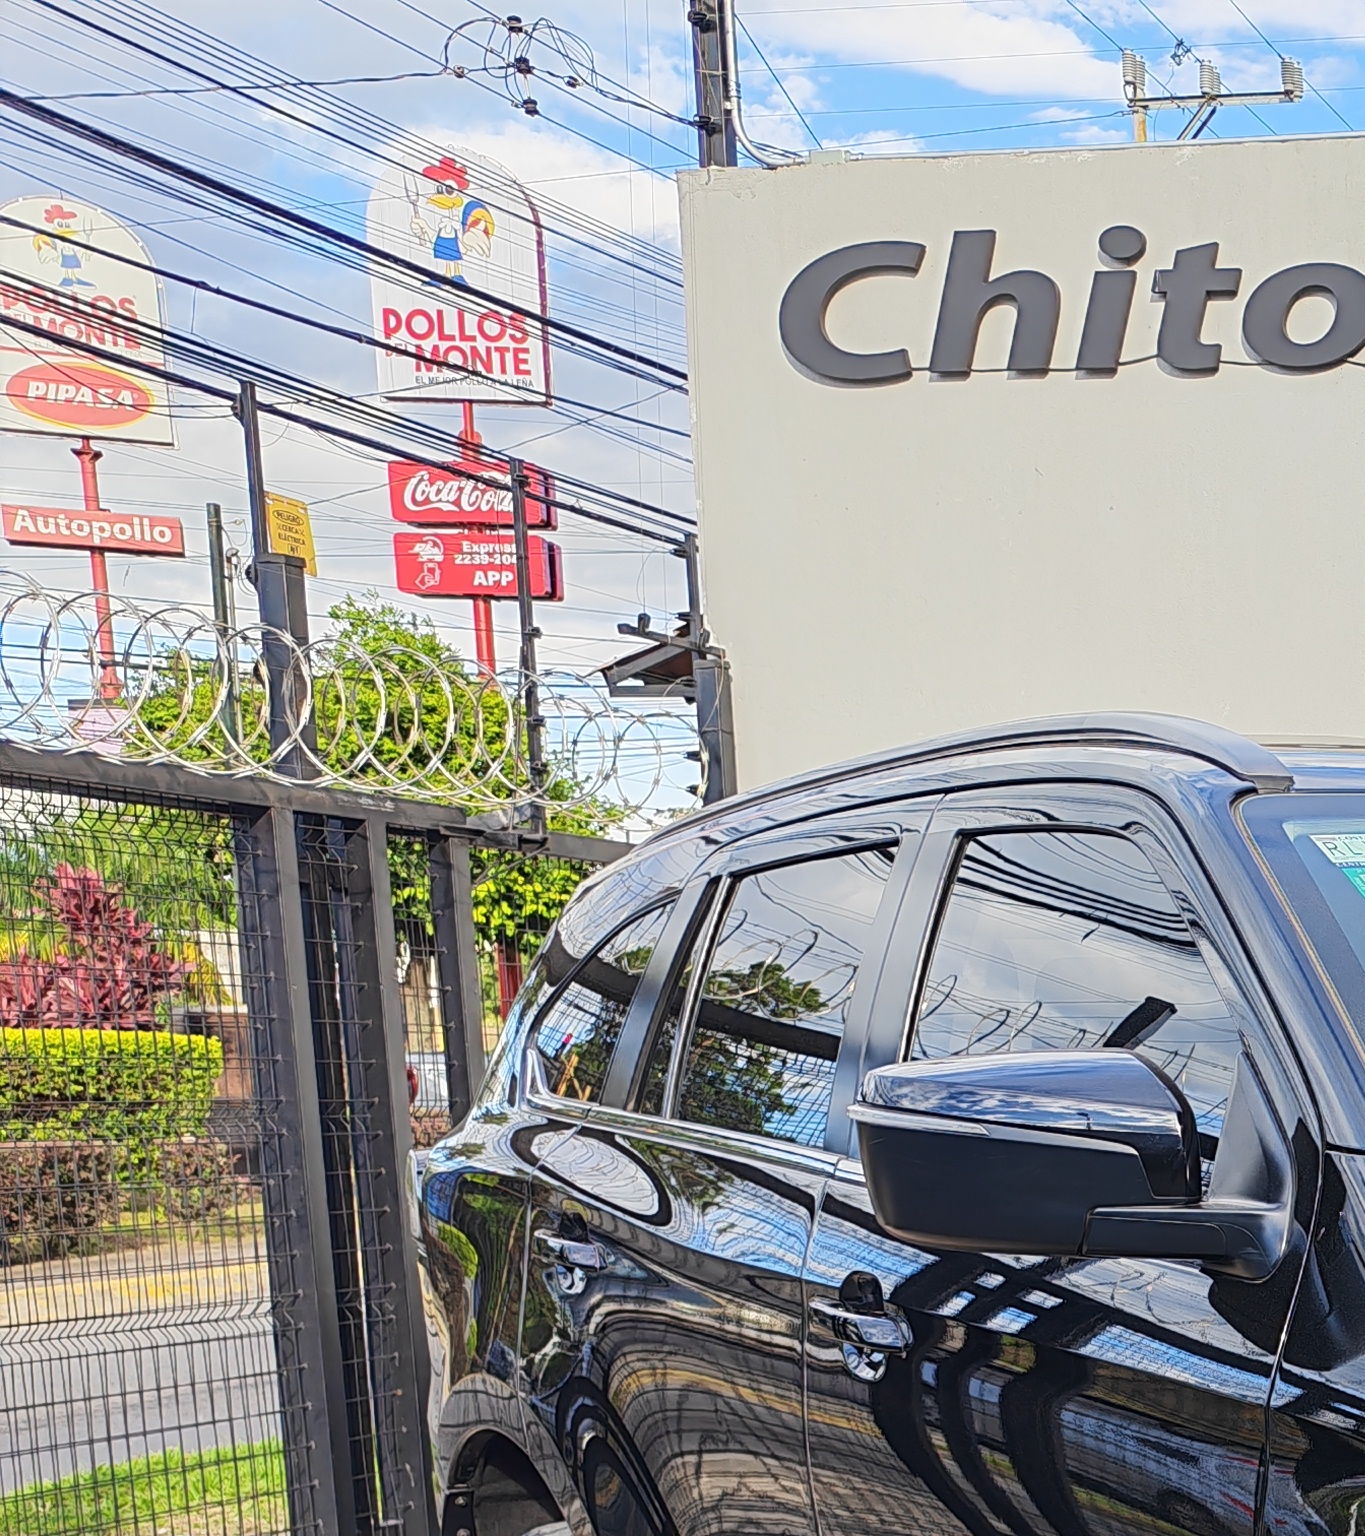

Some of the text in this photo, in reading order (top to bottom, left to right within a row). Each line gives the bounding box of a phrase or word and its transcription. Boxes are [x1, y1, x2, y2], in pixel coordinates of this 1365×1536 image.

[382, 307, 530, 345] POLLOS
[415, 344, 532, 377] MONTE
[27, 381, 135, 412] PIPASA
[13, 508, 173, 544] Autopollo
[473, 570, 514, 586] APP
